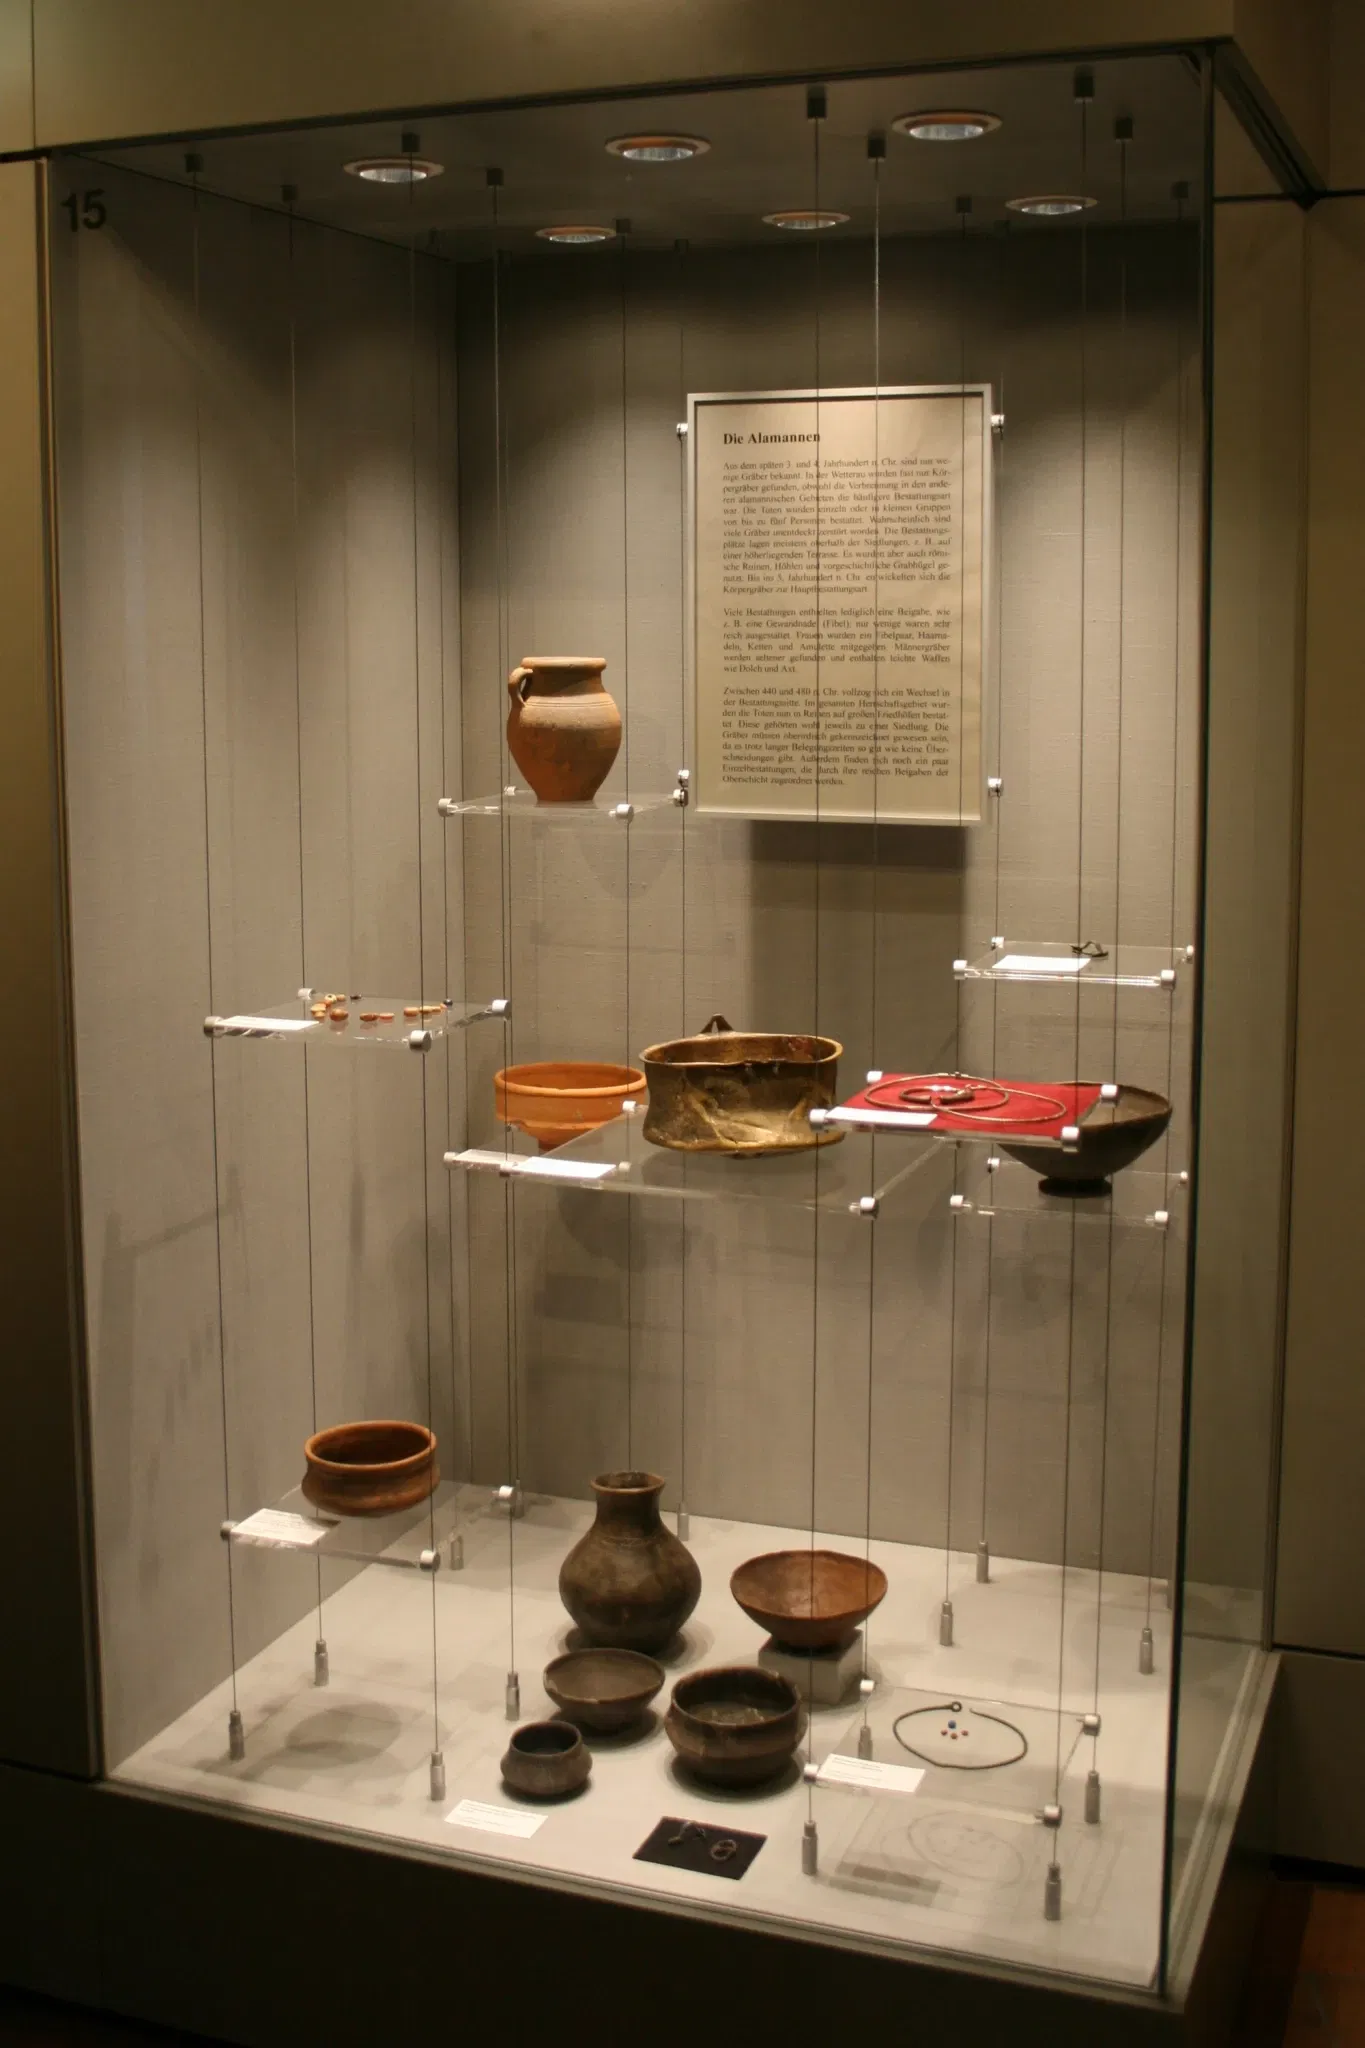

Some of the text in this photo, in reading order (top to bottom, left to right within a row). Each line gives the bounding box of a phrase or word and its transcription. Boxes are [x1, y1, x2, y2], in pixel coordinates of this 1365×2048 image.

[60, 188, 107, 232] 15
[724, 432, 821, 444] Die Alamannen
